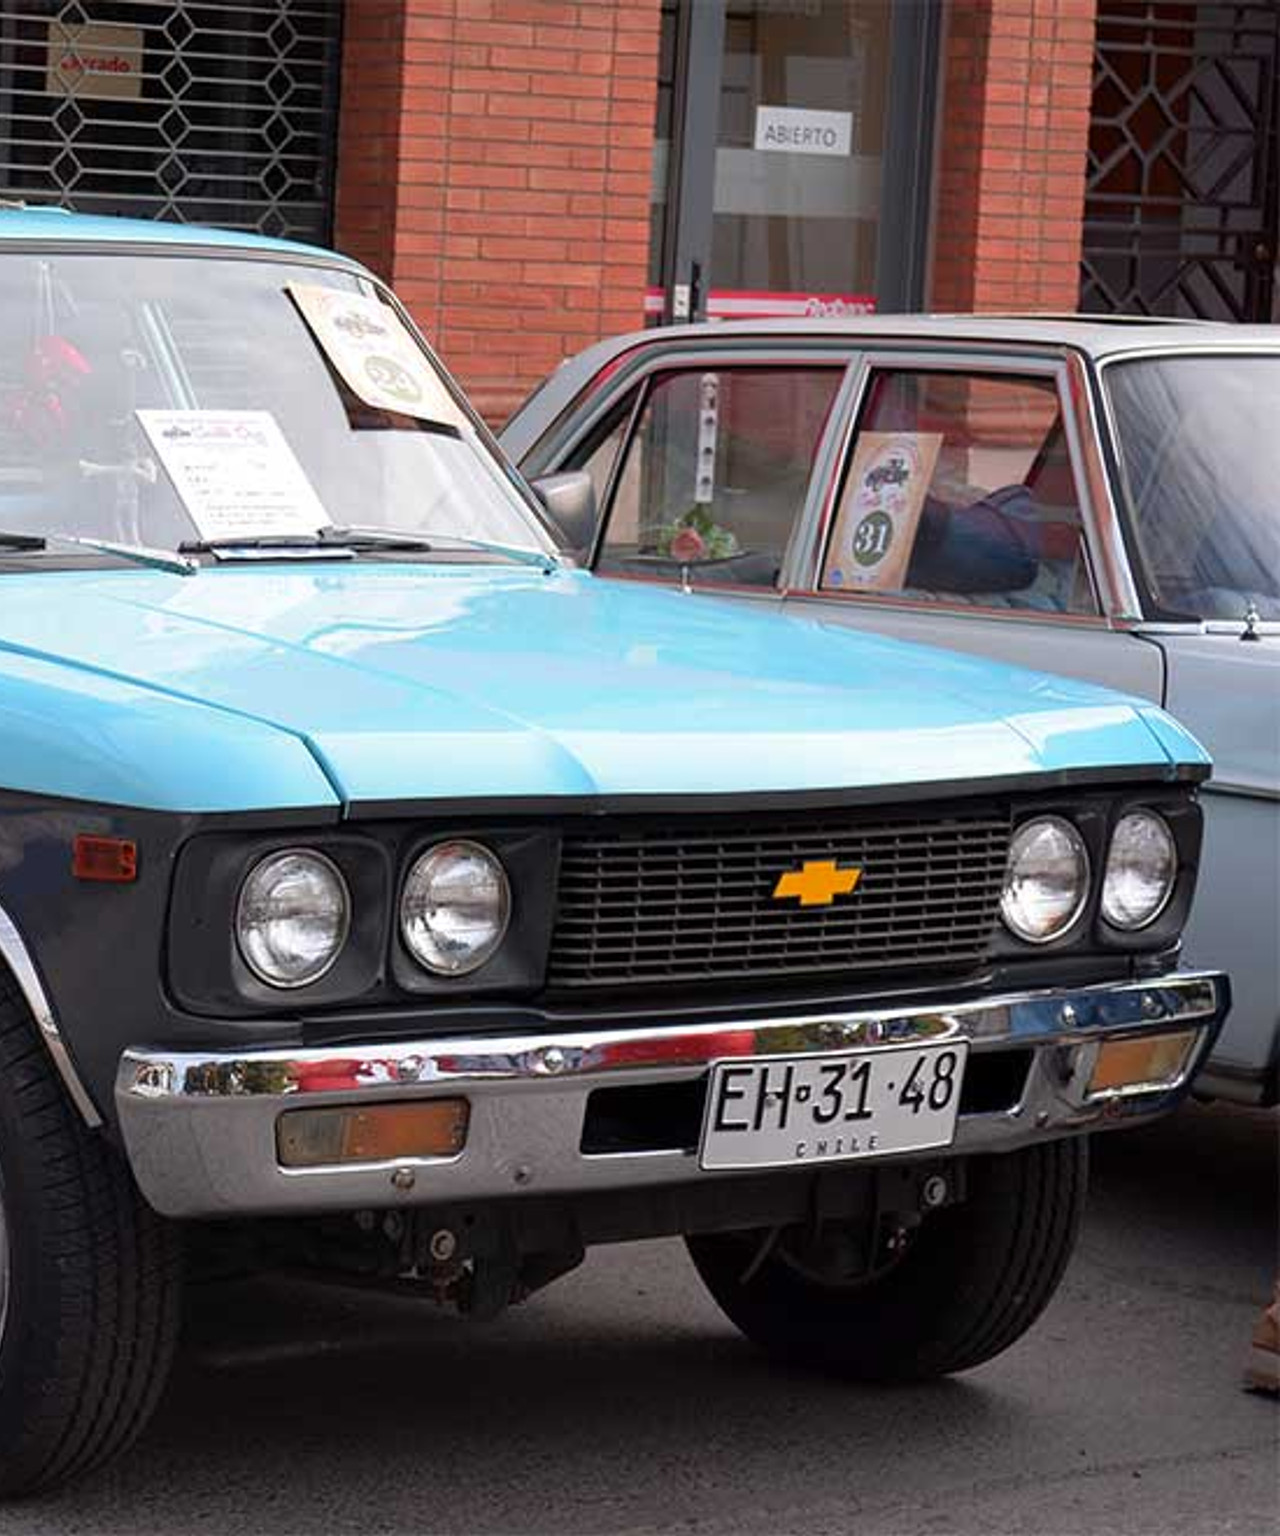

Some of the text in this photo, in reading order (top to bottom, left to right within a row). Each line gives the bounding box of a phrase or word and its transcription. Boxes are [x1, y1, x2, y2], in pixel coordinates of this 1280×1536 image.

[765, 125, 838, 147] ABIERTO
[855, 521, 888, 553] 31
[795, 1135, 880, 1158] CHILE
